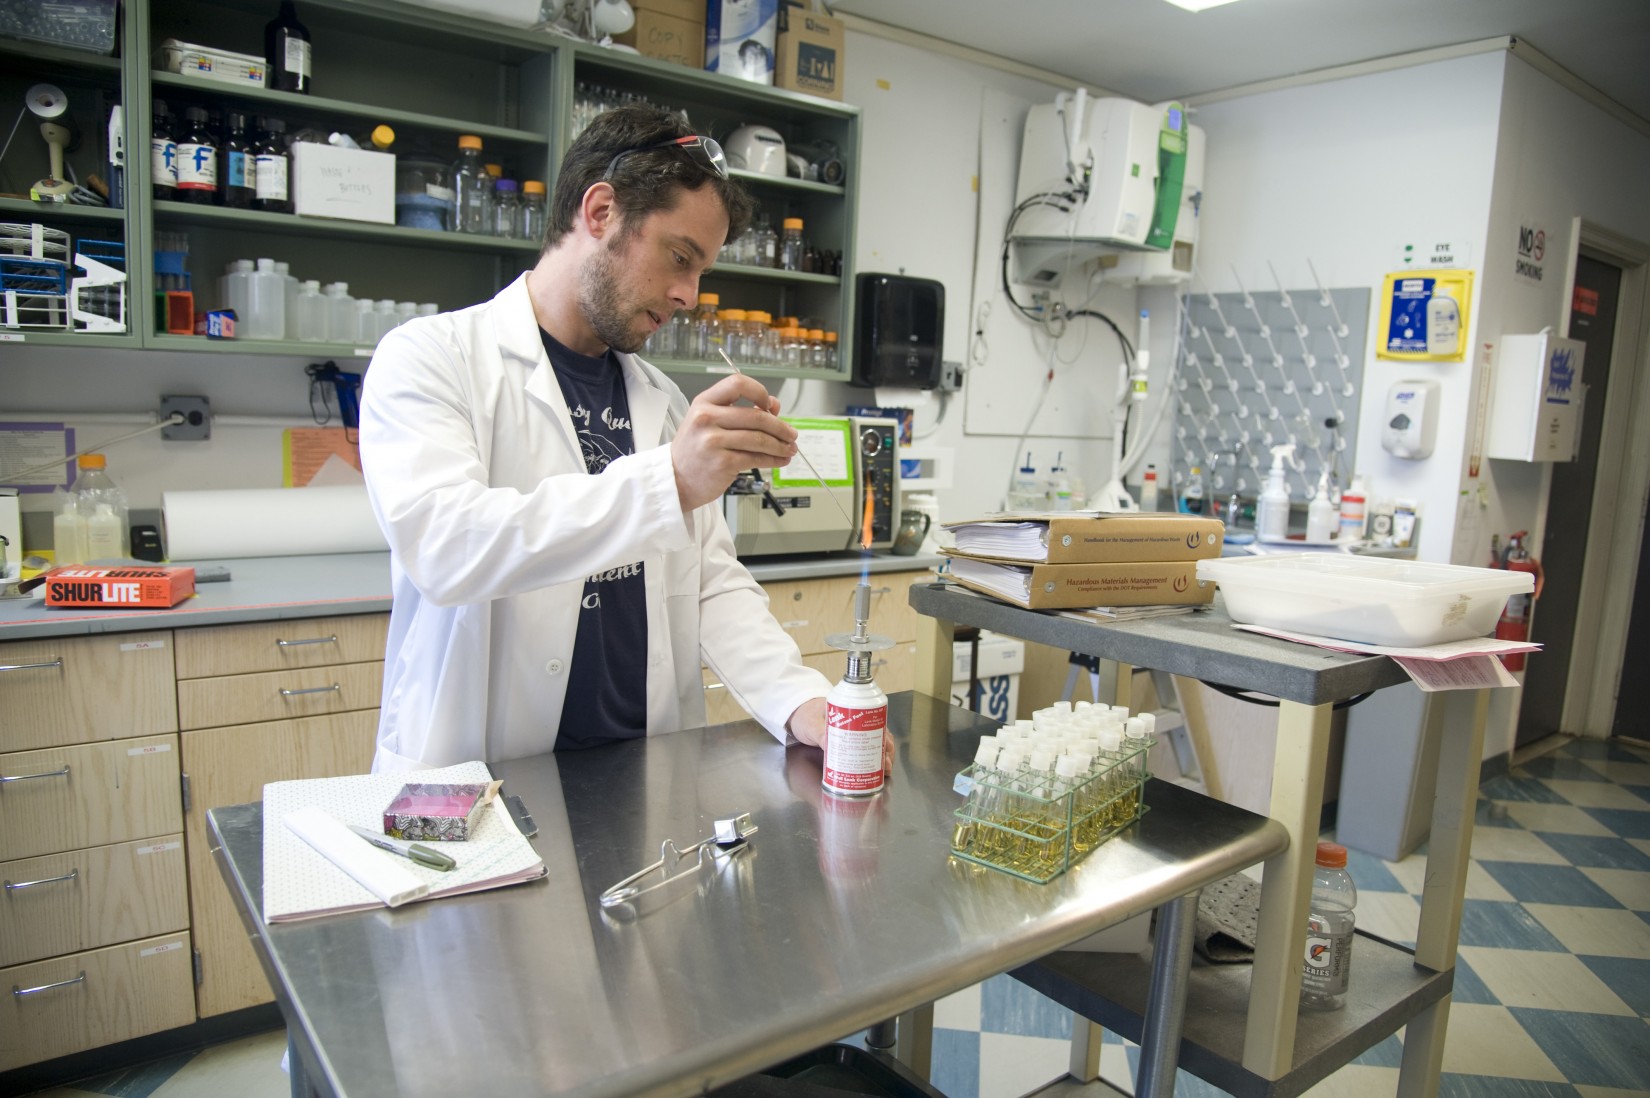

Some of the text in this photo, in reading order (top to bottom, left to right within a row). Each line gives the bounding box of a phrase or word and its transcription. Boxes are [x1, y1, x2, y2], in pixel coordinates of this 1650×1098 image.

[1519, 226, 1533, 253] NO
[1516, 259, 1542, 281] SMOKING
[1066, 578, 1100, 586] Hazardous
[1130, 577, 1168, 585] Management
[51, 582, 141, 602] SHURLITE
[1303, 965, 1330, 977] SERIES
